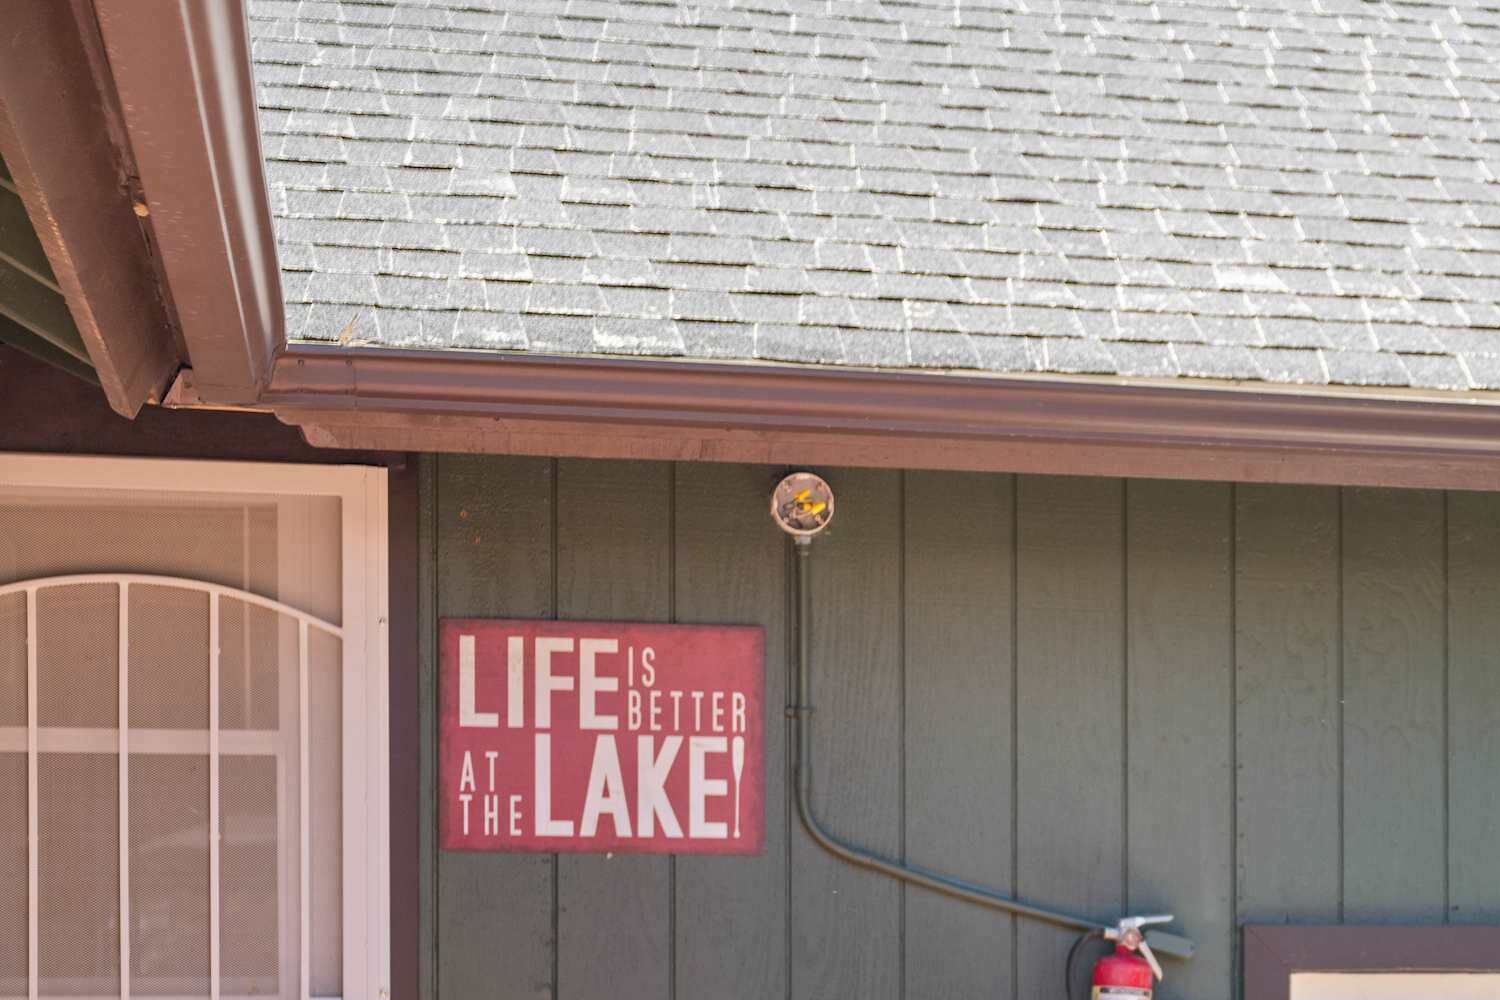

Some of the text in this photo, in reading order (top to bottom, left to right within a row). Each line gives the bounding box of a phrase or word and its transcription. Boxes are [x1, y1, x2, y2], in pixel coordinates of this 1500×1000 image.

[459, 635, 619, 730] LIFE
[628, 646, 656, 687] IS
[628, 690, 746, 732] BETTER
[459, 751, 499, 792] AT
[459, 794, 522, 836] THE
